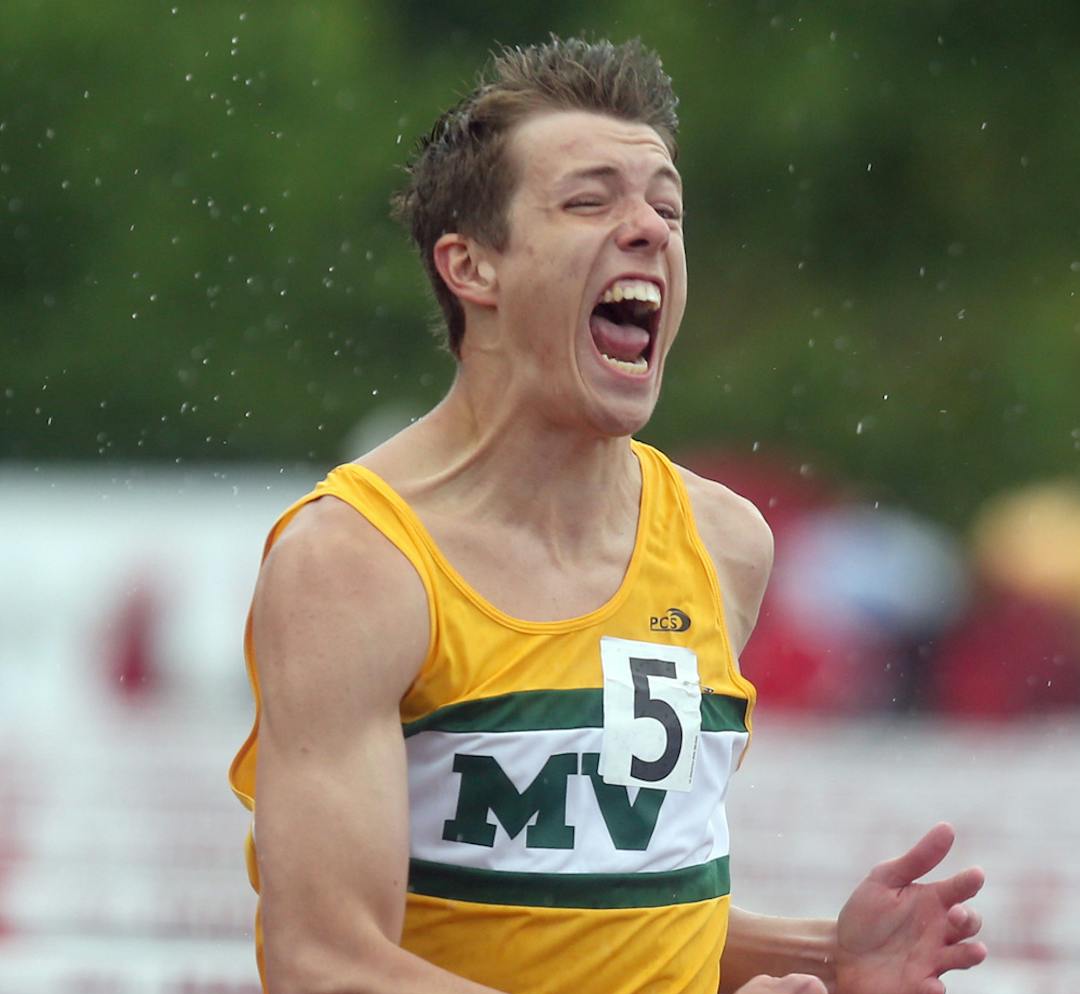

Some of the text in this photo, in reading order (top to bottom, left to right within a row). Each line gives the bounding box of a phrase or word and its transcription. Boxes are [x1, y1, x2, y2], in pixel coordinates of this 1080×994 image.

[649, 616, 678, 630] PCS
[629, 657, 683, 782] 5
[442, 752, 668, 851] MV
